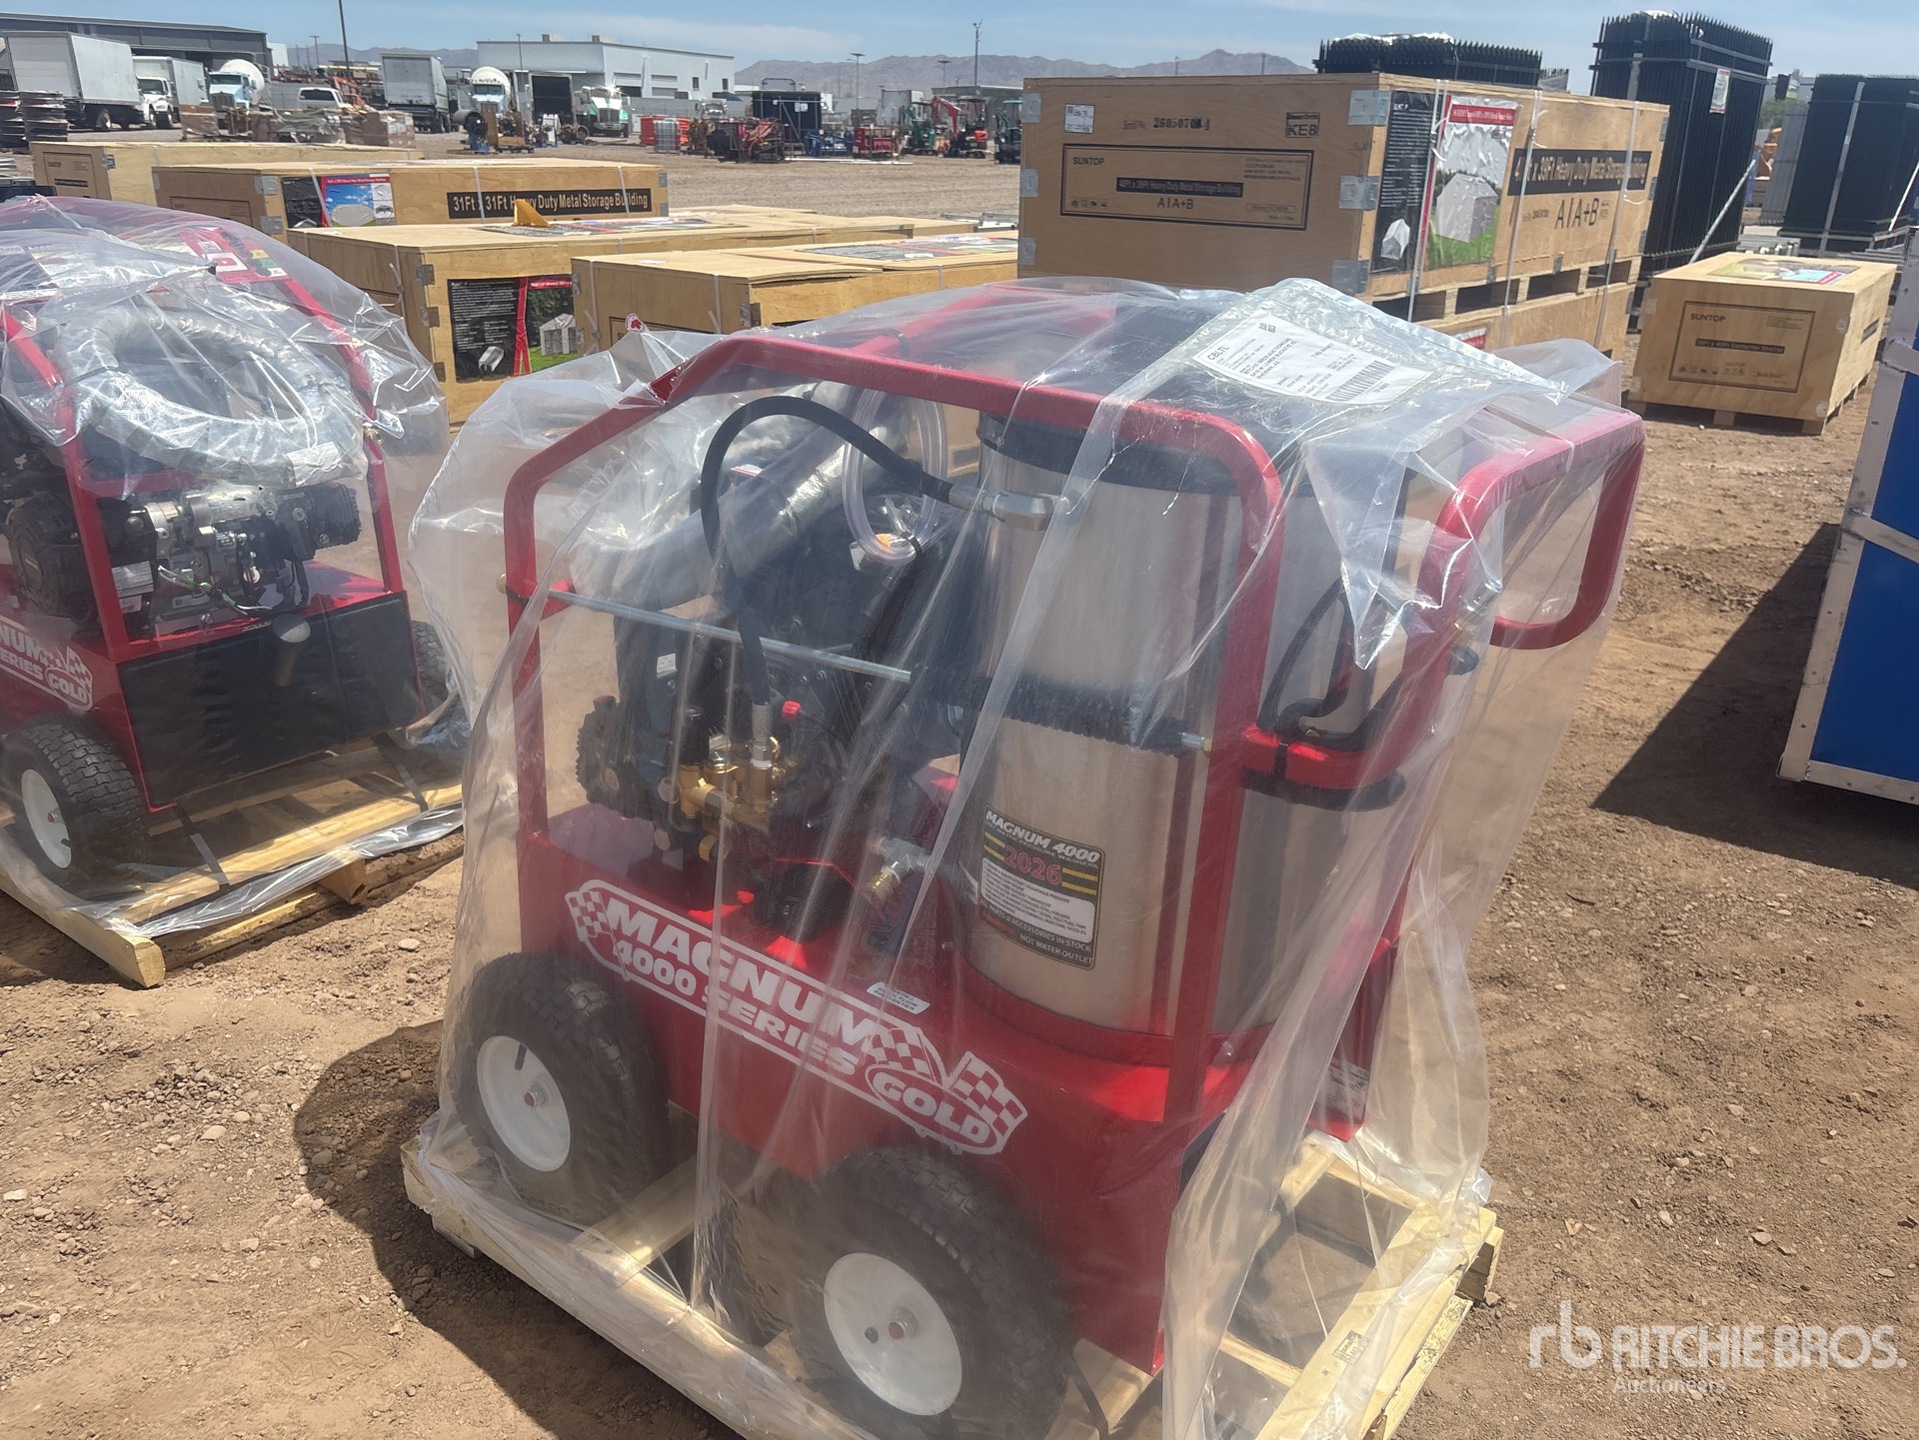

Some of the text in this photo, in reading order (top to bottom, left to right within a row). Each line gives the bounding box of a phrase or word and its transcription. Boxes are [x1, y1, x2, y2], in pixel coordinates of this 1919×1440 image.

[1072, 156, 1105, 166] SUNTOP
[453, 192, 648, 213] 31Ft 31Ft Hvy Duty Metal Storage Bulding
[1690, 313, 1726, 323] SUNTOP
[48, 672, 88, 704] GOLD
[985, 810, 1100, 863] MAGNUM 4000
[1005, 844, 1063, 886] 2026
[1011, 918, 1056, 941] ACCESSORIES
[1056, 933, 1066, 944] IN
[1065, 938, 1092, 953] STOCK
[1020, 933, 1094, 965] HOT WATER OUTLET
[606, 896, 881, 1055] MAGNUM
[612, 938, 860, 1076] 4000 SERIES
[872, 1071, 991, 1144] GOLD
